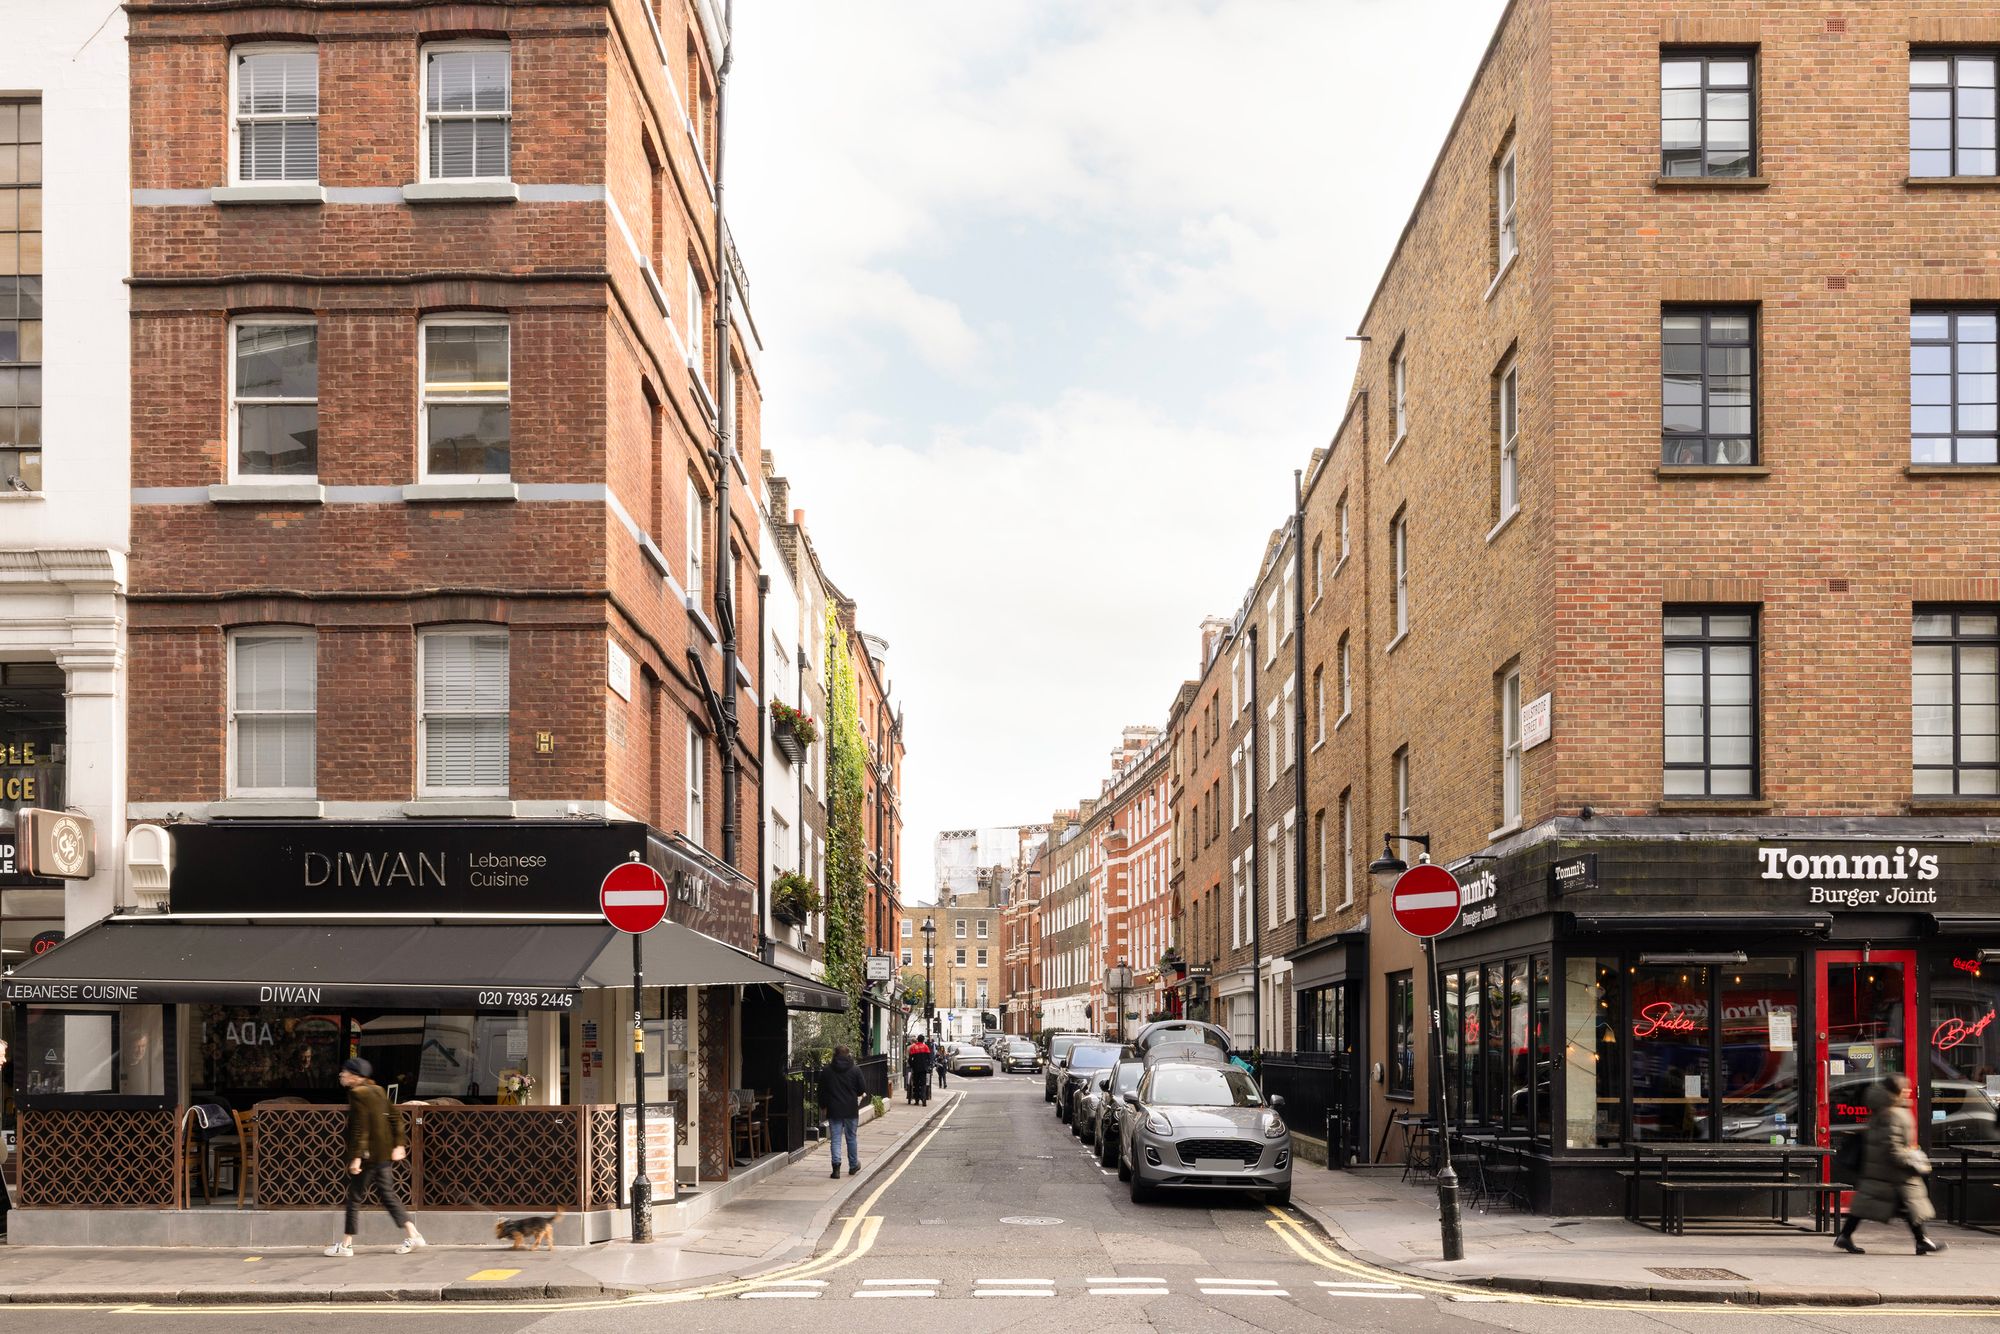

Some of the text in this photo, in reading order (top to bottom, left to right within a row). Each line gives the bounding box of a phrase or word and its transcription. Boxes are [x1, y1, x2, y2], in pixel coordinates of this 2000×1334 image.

[304, 851, 448, 887] DIWAN
[469, 852, 547, 868] Lebanese
[1555, 860, 1586, 880] Tommi's
[1757, 846, 1940, 880] Tommi's
[469, 871, 529, 887] Cuisine
[1460, 870, 1498, 907] mmi's
[1809, 886, 1937, 907] Burger Joint
[1462, 903, 1498, 927] Burger Joint
[6, 985, 138, 999] LEBANESE CUISINE
[260, 986, 321, 1003] DIWAN
[478, 991, 573, 1007] 020 7935 2445
[1633, 1001, 1696, 1037] Shakes
[1930, 1008, 1997, 1051] Burgers
